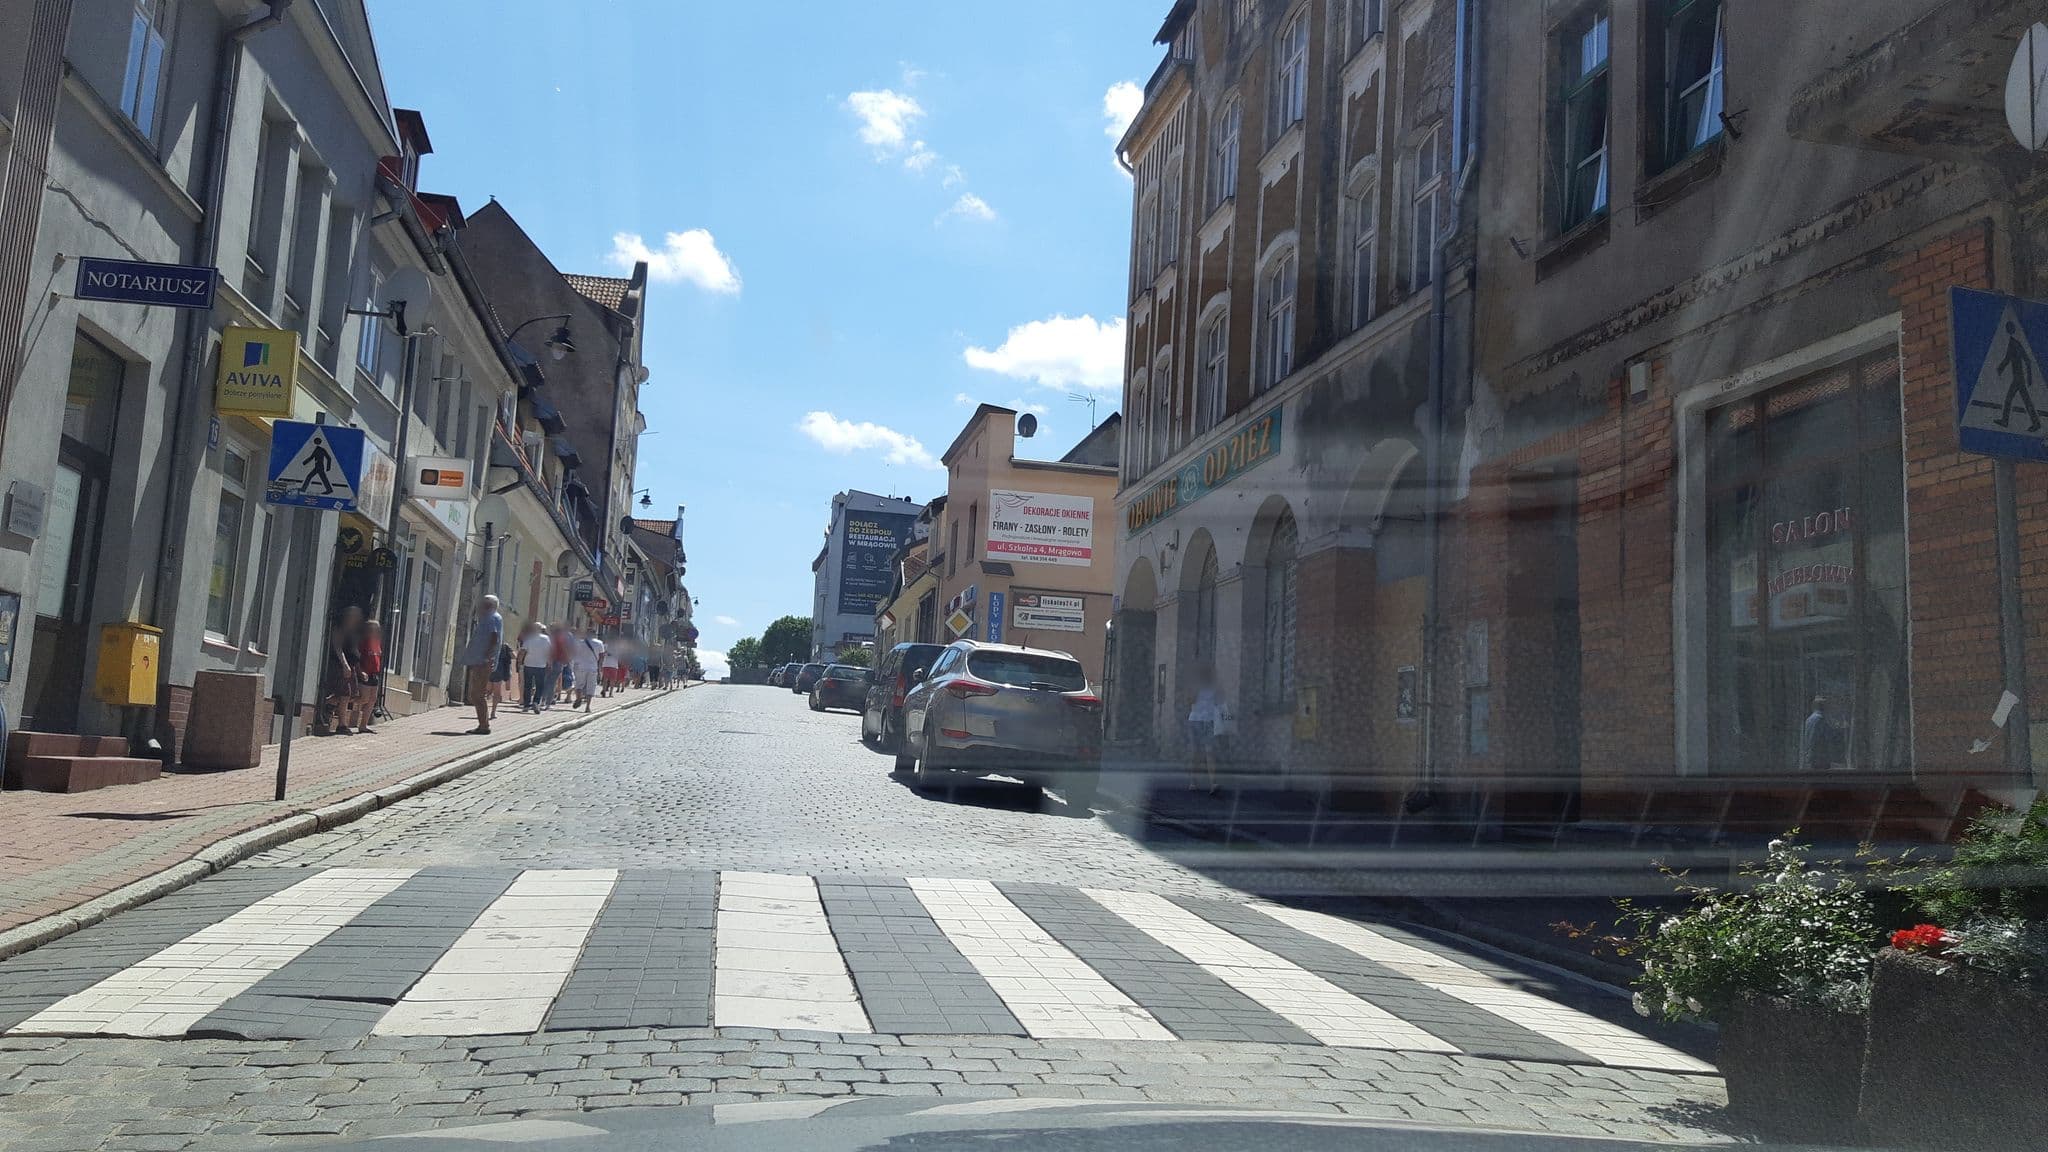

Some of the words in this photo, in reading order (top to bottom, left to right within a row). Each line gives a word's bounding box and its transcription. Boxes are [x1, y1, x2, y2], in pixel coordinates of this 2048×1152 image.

[87, 271, 206, 295] NOTARIUSZ
[226, 372, 282, 388] AVIVA
[1128, 475, 1178, 531] OBUWIE
[1023, 506, 1060, 518] DEKORACJE
[1061, 510, 1090, 520] OKIENNE
[862, 528, 892, 536] ZESPOŁU
[992, 521, 1019, 532] FIRANY
[1024, 523, 1056, 535] ZASŁONY
[1062, 527, 1089, 537] ROLETY
[1772, 507, 1853, 543] SALON
[848, 533, 896, 543] RESTAURACJI
[857, 540, 897, 549] MRĄGOWIE
[1008, 544, 1038, 553] Szkolna
[1048, 548, 1082, 557] Mrągowo
[1768, 563, 1856, 597] MEBLOWY
